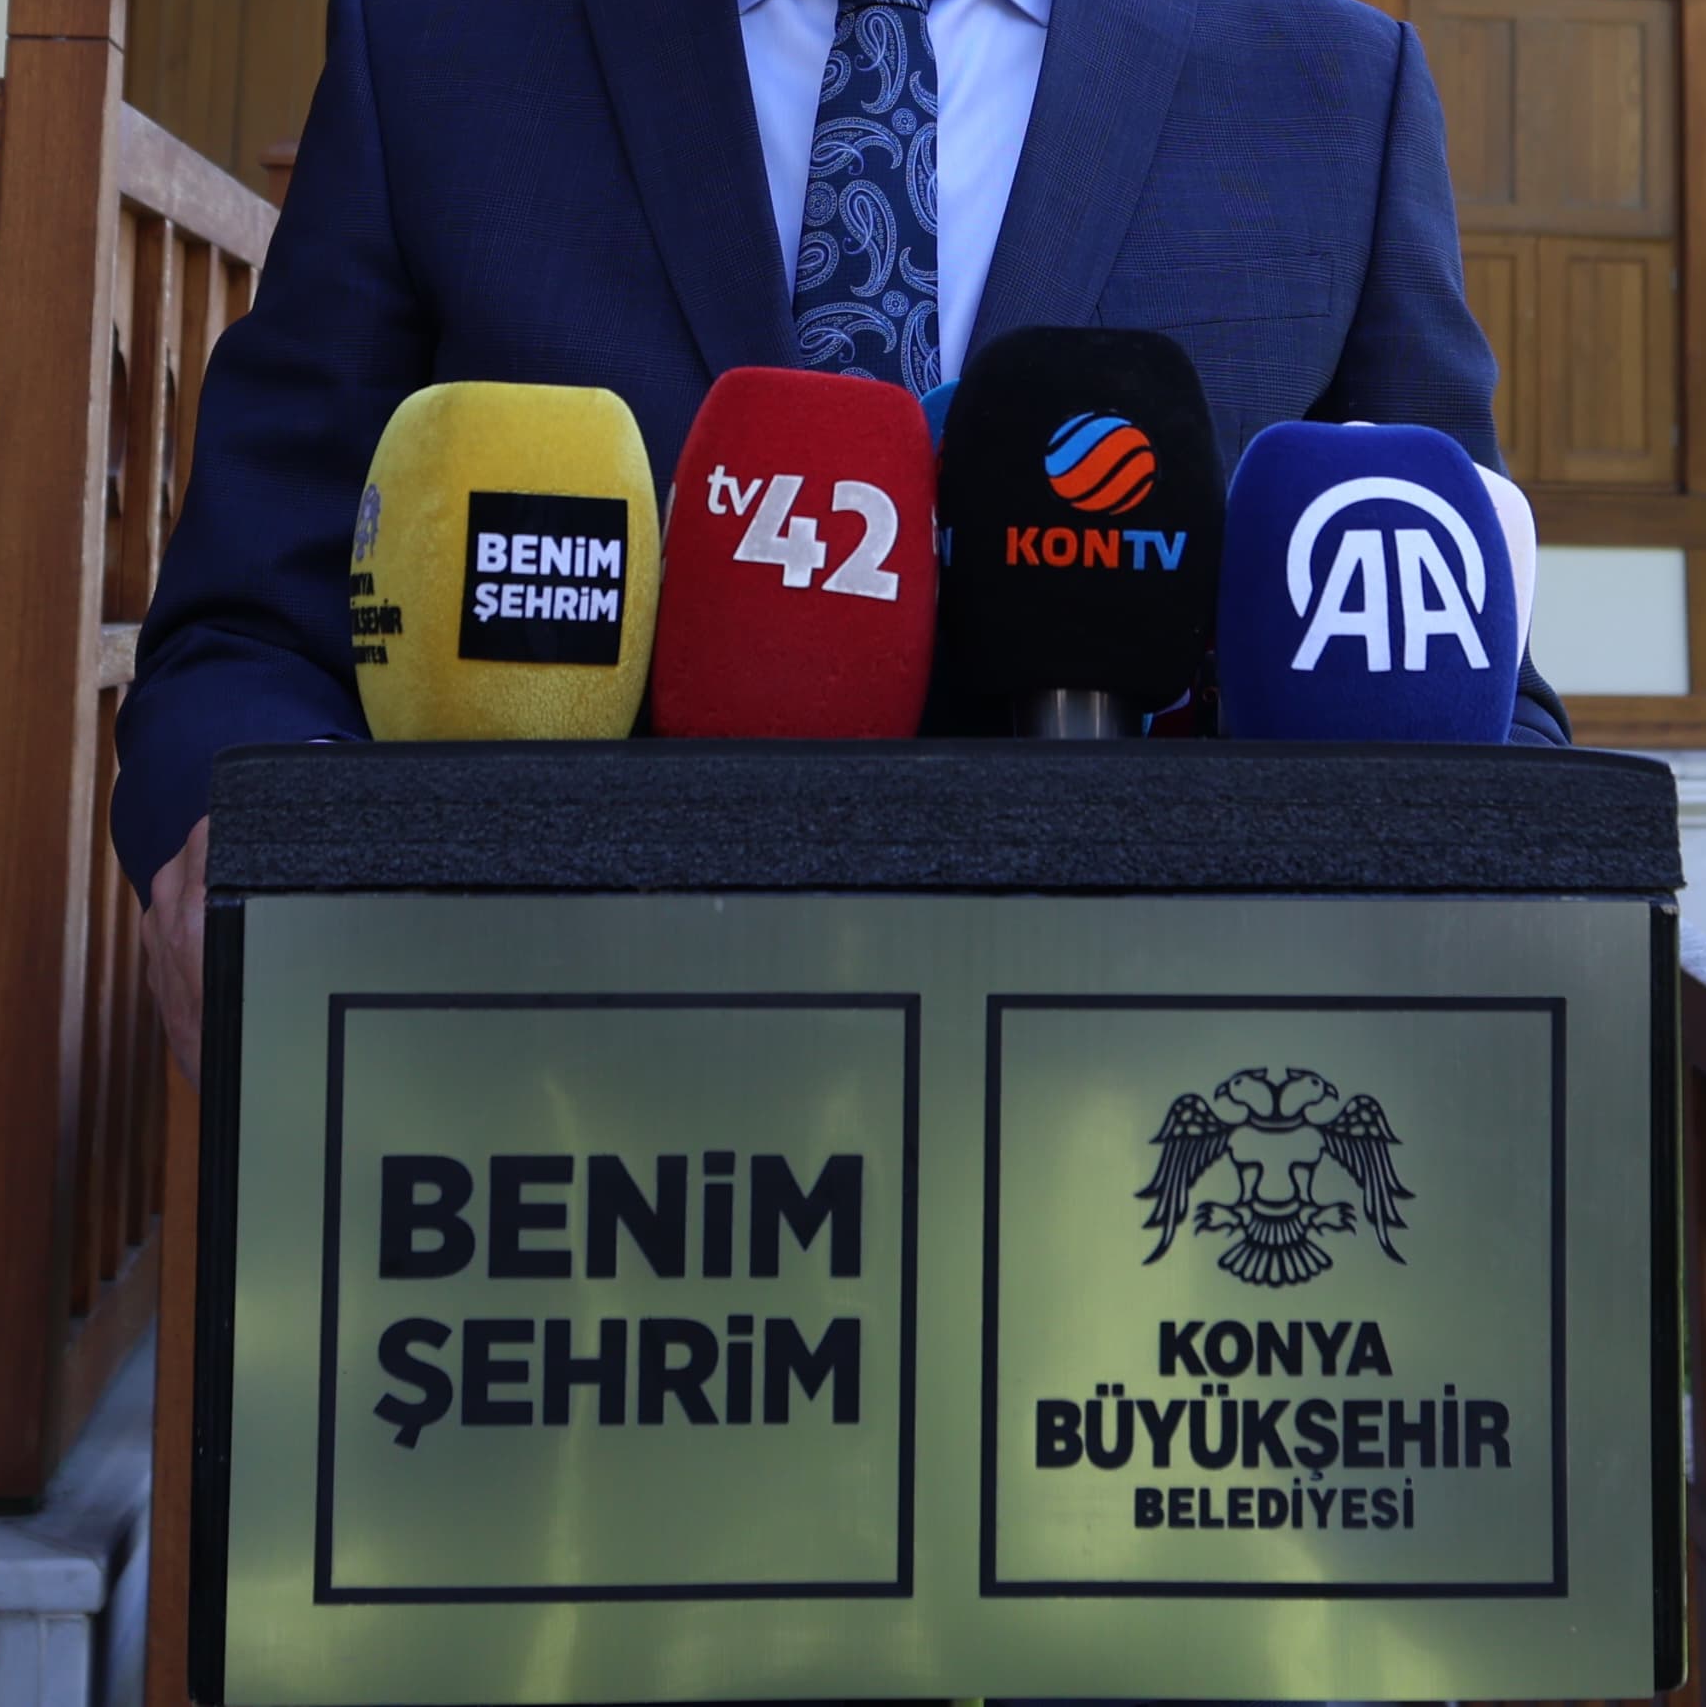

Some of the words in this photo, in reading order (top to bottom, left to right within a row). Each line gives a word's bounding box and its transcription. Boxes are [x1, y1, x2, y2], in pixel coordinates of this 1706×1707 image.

[1291, 529, 1490, 672] AA
[1158, 1320, 1393, 1379] KONYA
[1035, 1382, 1512, 1481] BÜYÜKŞEHİR
[1134, 1477, 1415, 1530] BELEDİYESİ
